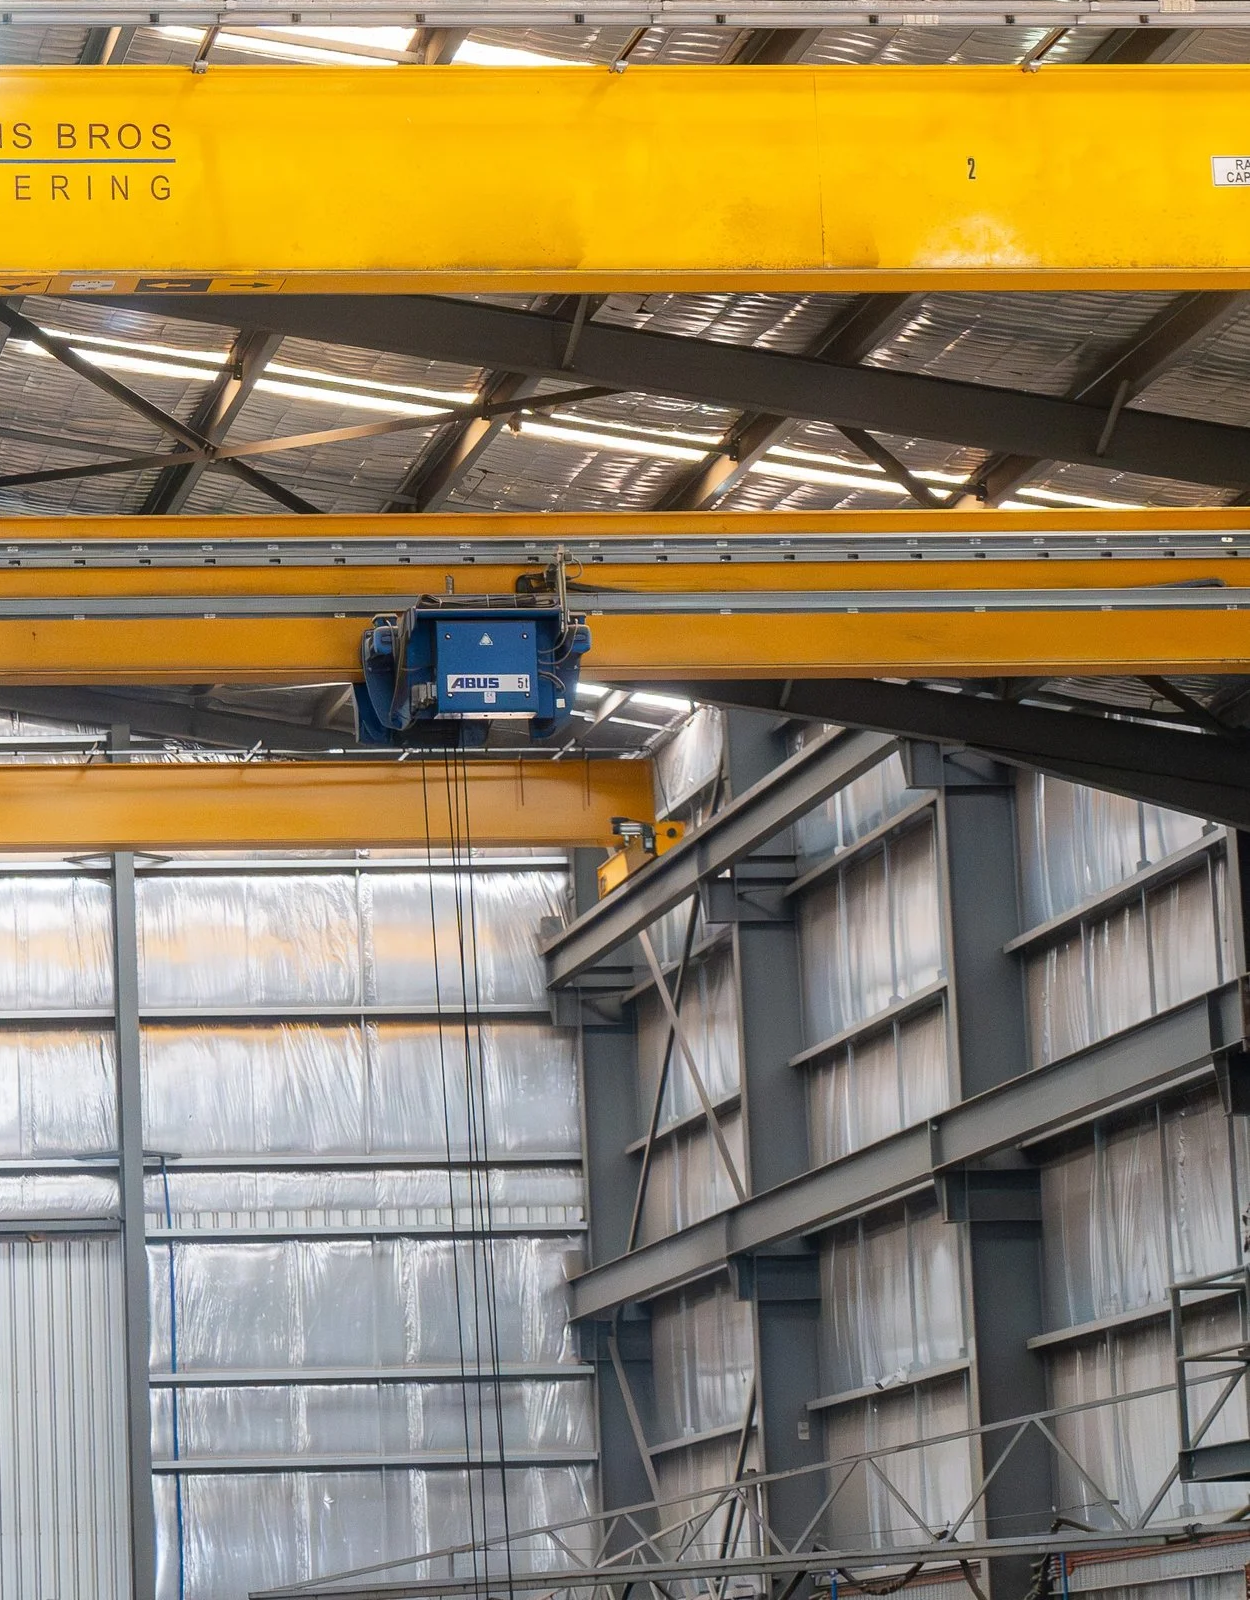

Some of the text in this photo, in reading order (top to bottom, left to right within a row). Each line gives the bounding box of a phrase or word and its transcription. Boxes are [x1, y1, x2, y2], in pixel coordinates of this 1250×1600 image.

[57, 123, 172, 150] BROS
[967, 157, 976, 180] 2
[450, 677, 500, 689] ABUS
